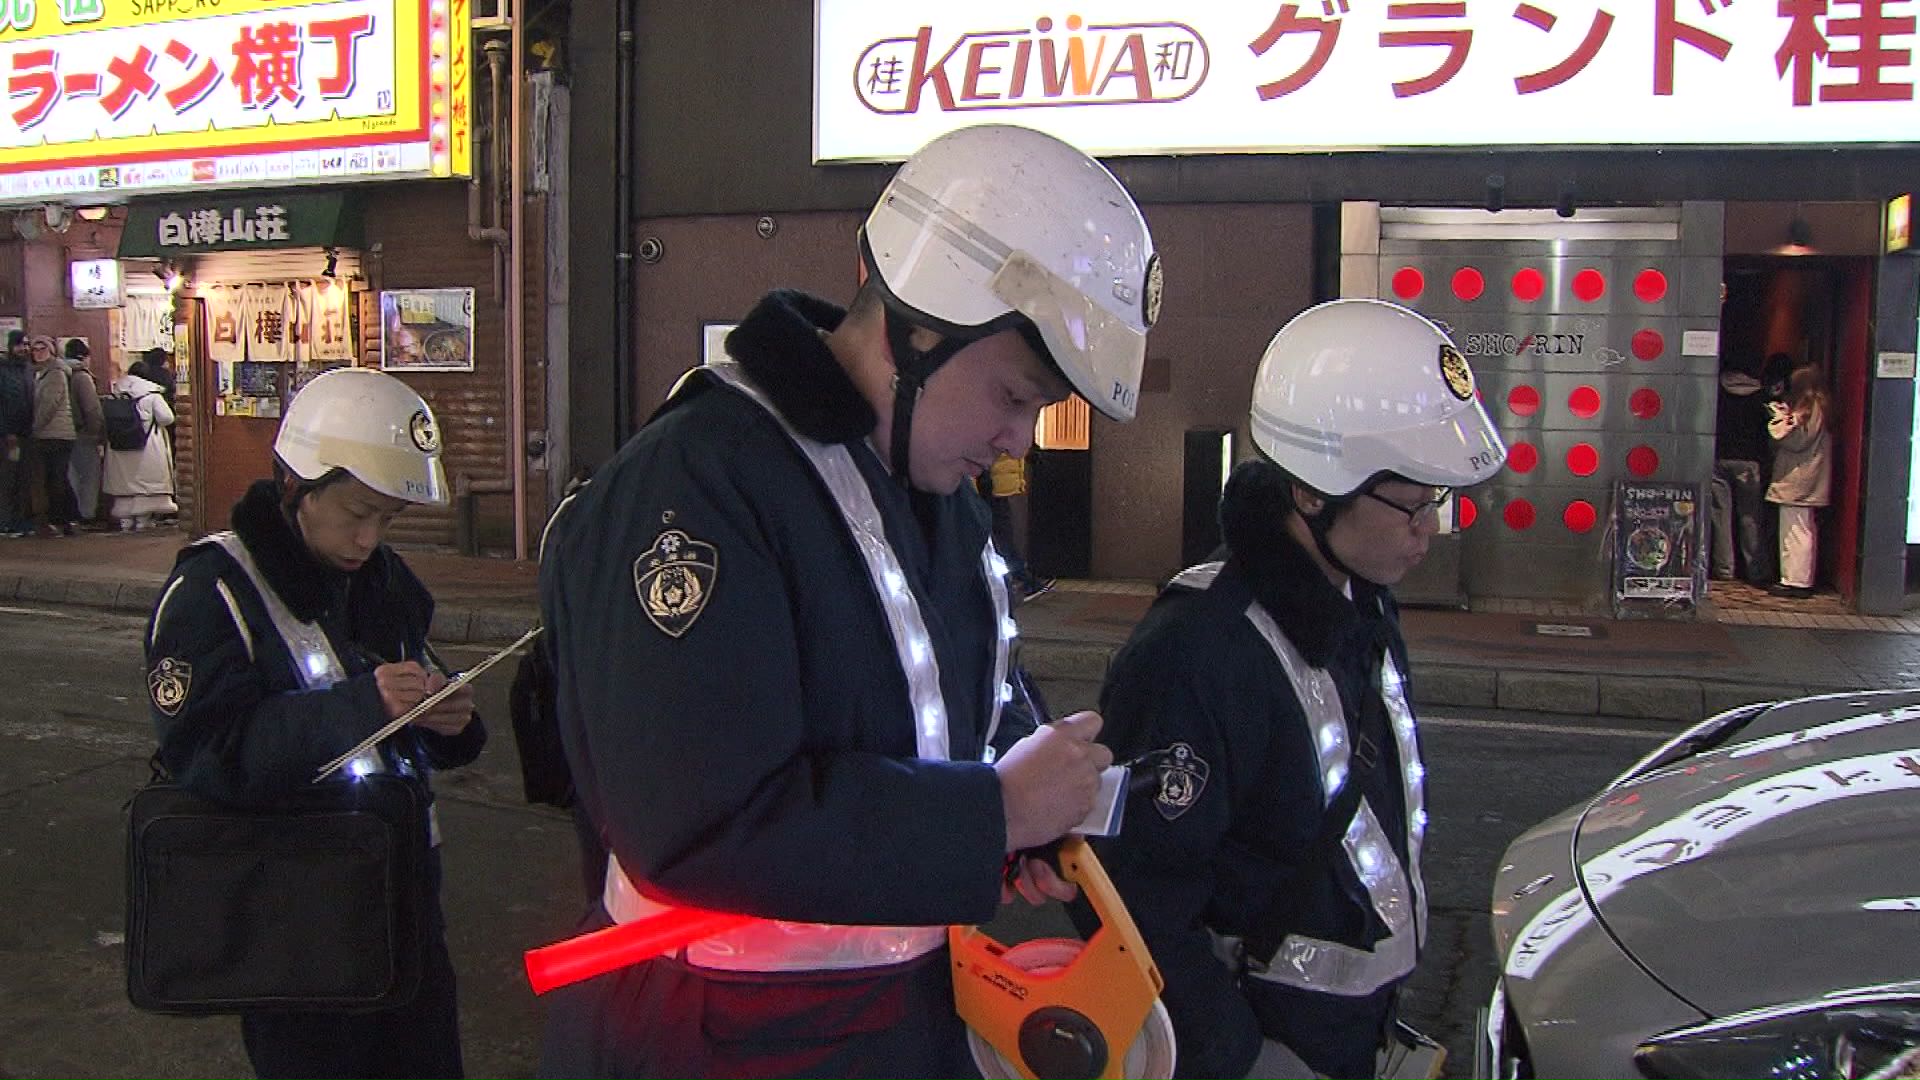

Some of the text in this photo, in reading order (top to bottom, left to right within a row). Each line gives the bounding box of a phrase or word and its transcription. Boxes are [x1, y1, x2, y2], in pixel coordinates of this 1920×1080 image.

[8, 14, 373, 131] ラーメン横丁
[867, 14, 1194, 112] 桂 KEIWA 和
[1249, 0, 1916, 107] グランド桂
[159, 204, 290, 245] 白樺山荘
